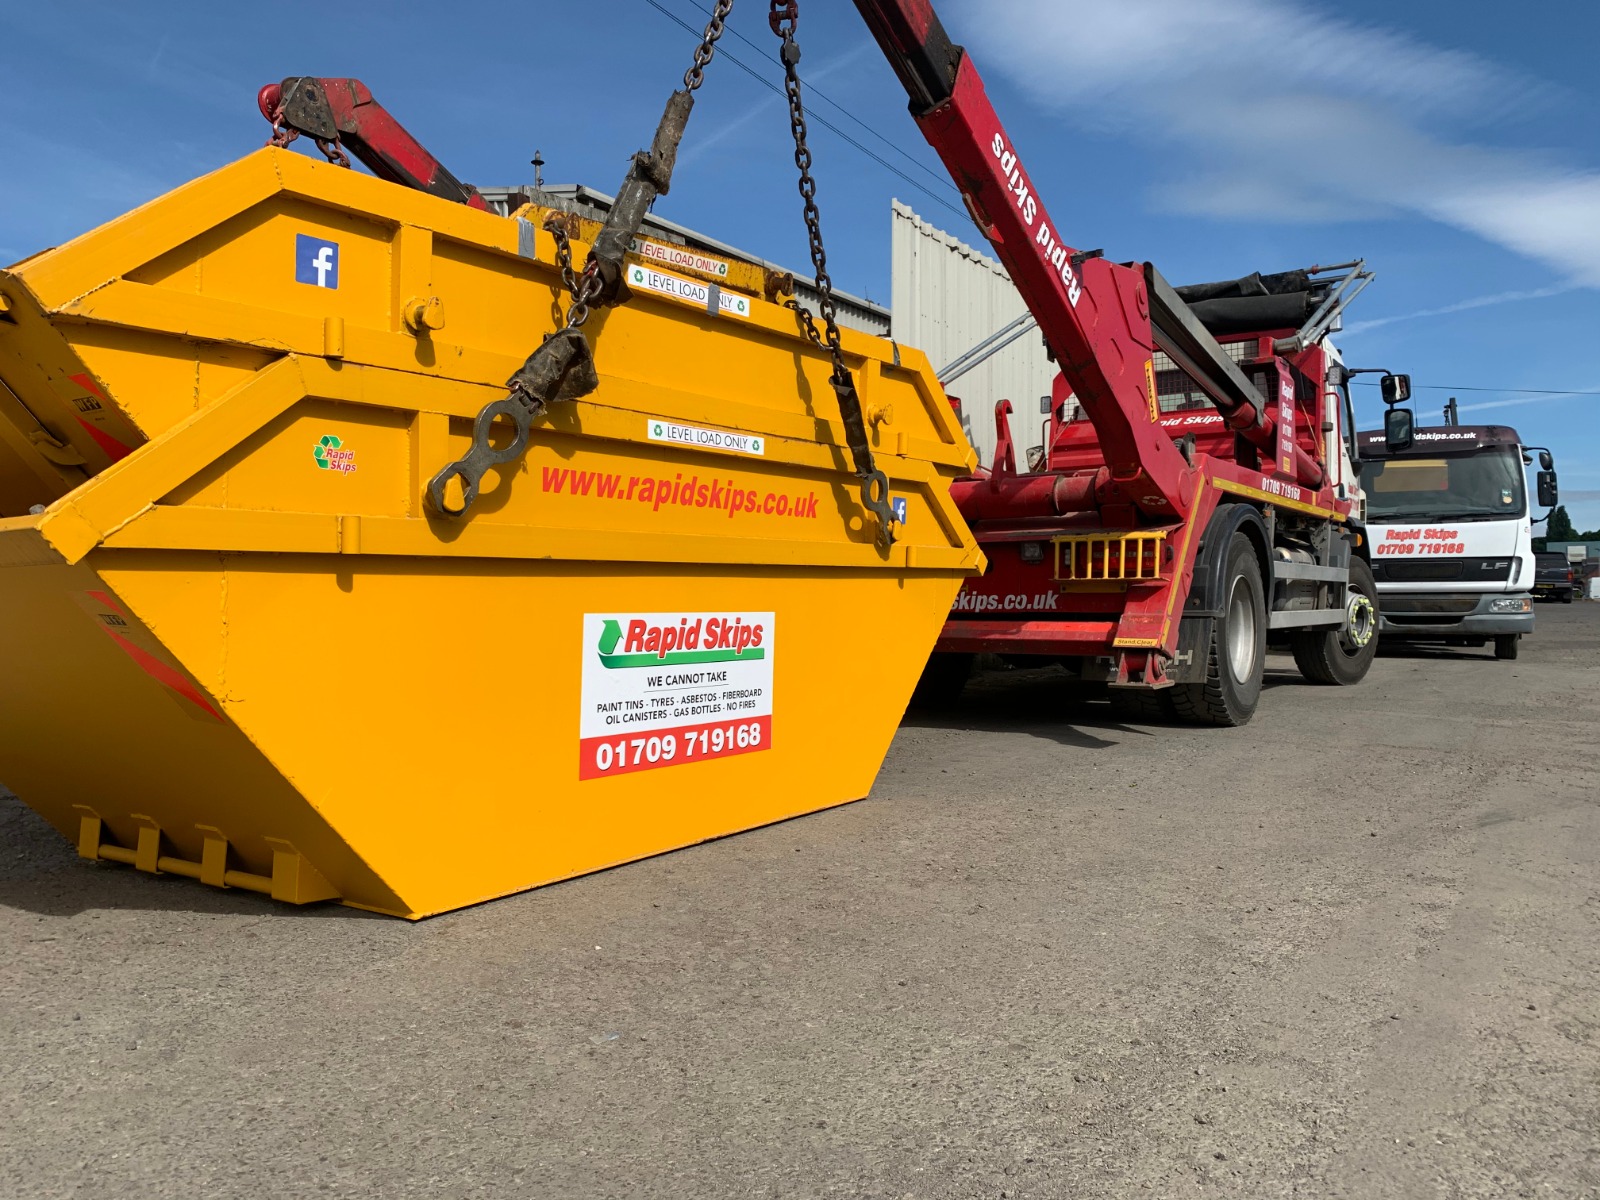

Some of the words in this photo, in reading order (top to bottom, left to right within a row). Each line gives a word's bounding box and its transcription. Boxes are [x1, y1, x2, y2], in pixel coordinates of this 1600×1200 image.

[992, 133, 1037, 226] Skips
[640, 242, 667, 260] LEVEL
[670, 251, 694, 267] LOAD
[696, 258, 719, 273] ONLY
[1036, 221, 1082, 308] Rapid
[648, 273, 676, 293] LEVEL
[680, 282, 706, 300] LOAD
[1184, 415, 1224, 425] Skips
[667, 426, 693, 442] LEVEL
[697, 431, 722, 446] LOAD
[724, 435, 748, 449] ONLY
[326, 449, 354, 461] Rapid
[331, 460, 356, 475] Skips
[542, 466, 819, 519] www.rapidskips.co.uk
[1262, 478, 1280, 494] 01709
[1280, 483, 1300, 500] 719168
[1385, 529, 1421, 541] Rapid
[1424, 528, 1458, 541] Skips
[1377, 543, 1414, 555] 01709
[1418, 543, 1465, 554] 719168
[1481, 562, 1508, 570] LF
[624, 618, 703, 658] Rapid
[703, 617, 764, 654] Skips
[647, 676, 663, 687] WE
[665, 673, 704, 686] CANNOT
[706, 671, 727, 682] TAKE
[597, 701, 623, 713] PAINT
[625, 700, 644, 711] TINS
[650, 698, 674, 708] TYRES
[681, 693, 717, 705] ASBESTOS
[722, 688, 762, 700] FIBERBOARD
[606, 715, 620, 725] OIL
[623, 709, 667, 723] CANISTERS
[673, 707, 689, 717] GAS
[691, 704, 721, 715] BOTTLES
[726, 702, 737, 711] NO
[739, 700, 756, 710] FIRES
[596, 735, 676, 771] 01709
[684, 722, 761, 757] 719168
